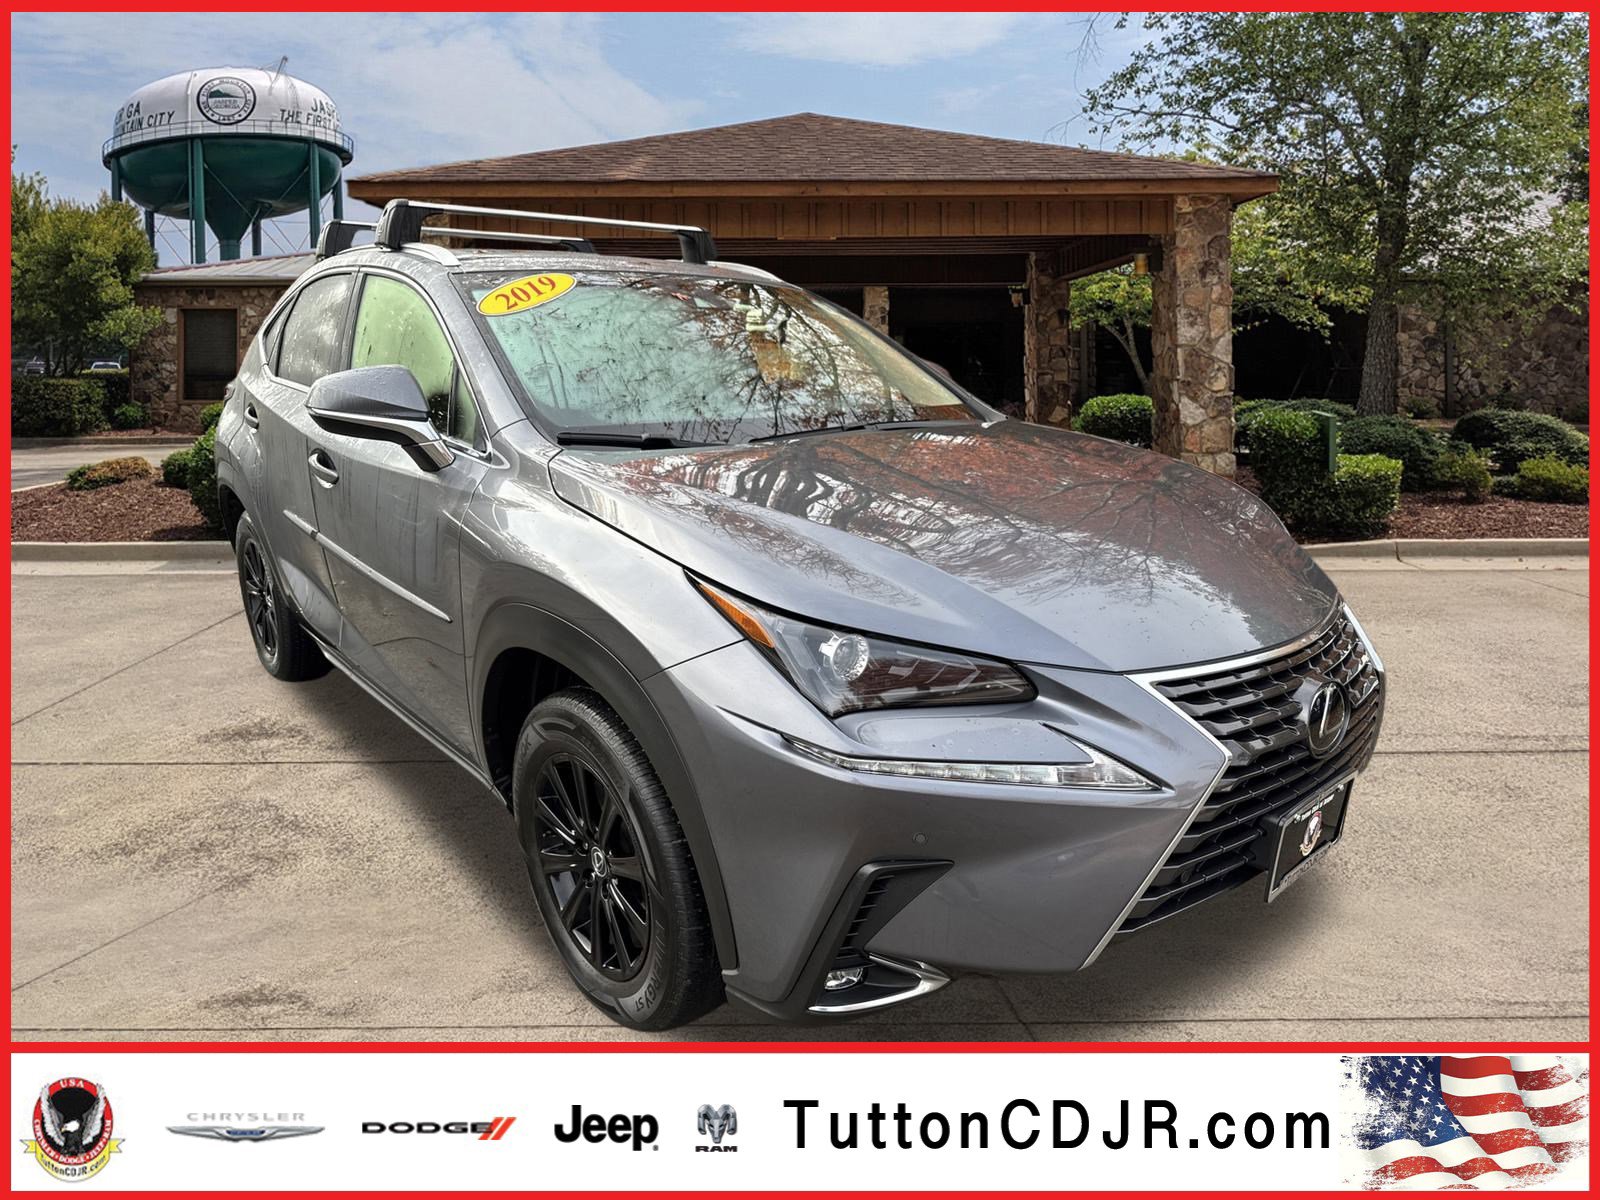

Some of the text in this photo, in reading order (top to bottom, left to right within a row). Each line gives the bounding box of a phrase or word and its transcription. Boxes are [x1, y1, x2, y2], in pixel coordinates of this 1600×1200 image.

[127, 101, 141, 119] GA
[147, 110, 175, 128] CITY
[280, 109, 302, 124] THE
[495, 276, 557, 311] 2019
